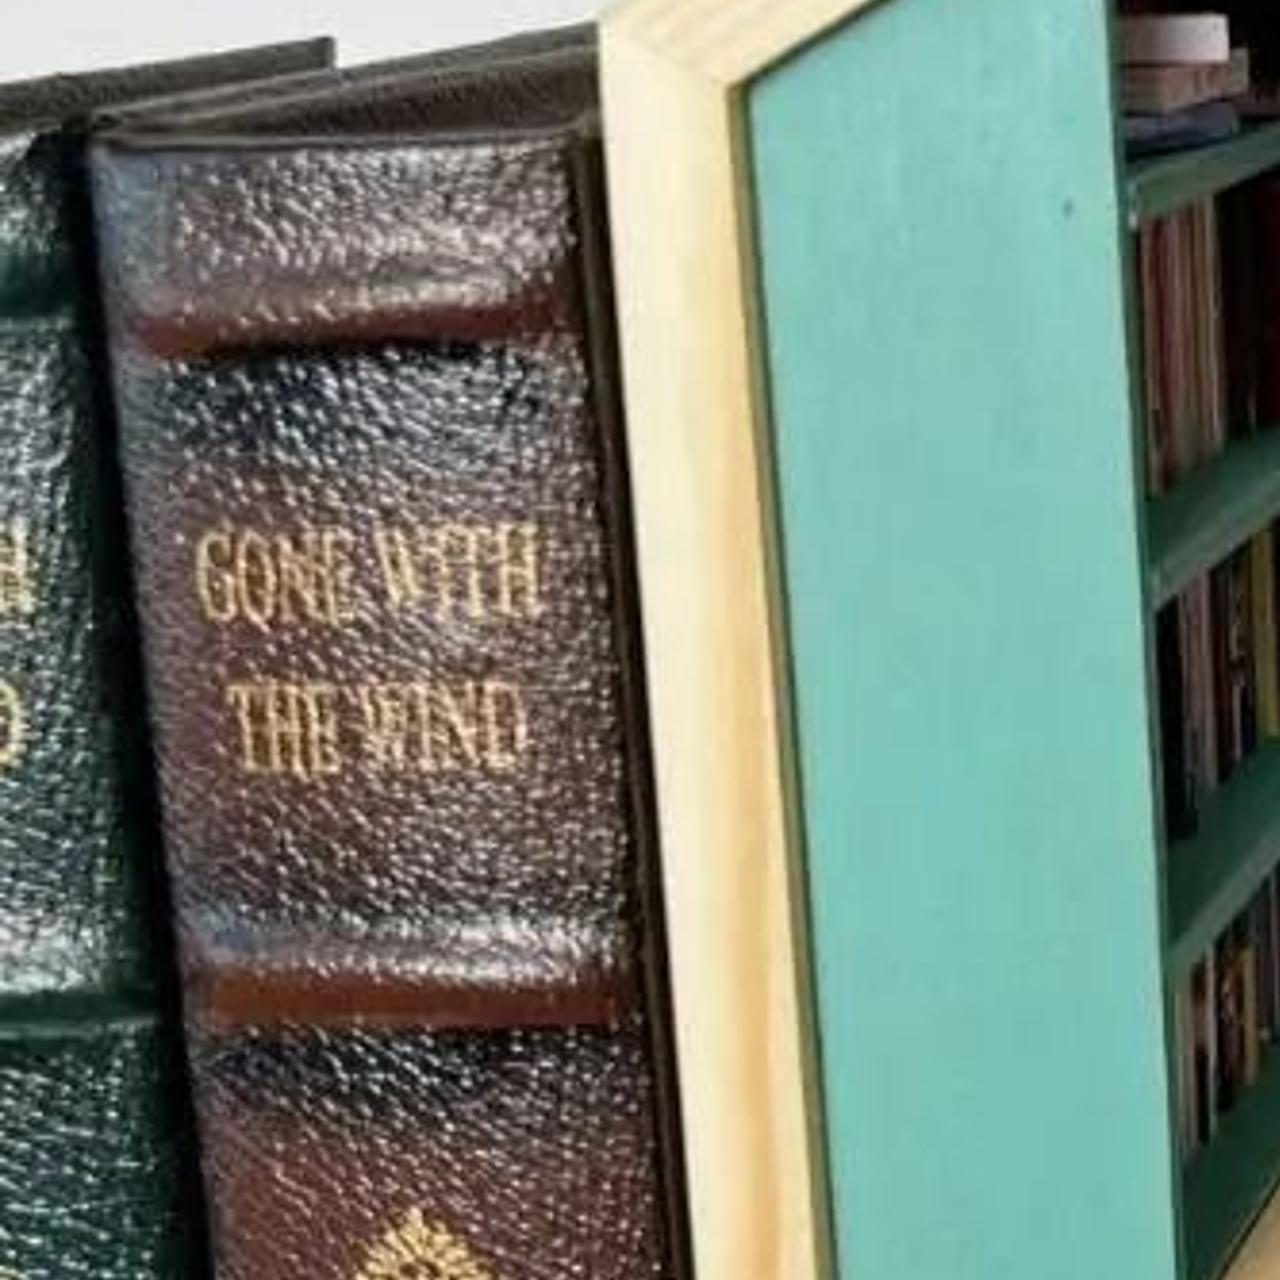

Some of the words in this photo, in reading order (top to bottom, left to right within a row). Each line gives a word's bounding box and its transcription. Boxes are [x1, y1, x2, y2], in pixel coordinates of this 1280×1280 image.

[194, 522, 346, 624] GONE
[376, 523, 542, 624] WITH
[227, 684, 339, 777] THE
[358, 683, 527, 773] WIND
